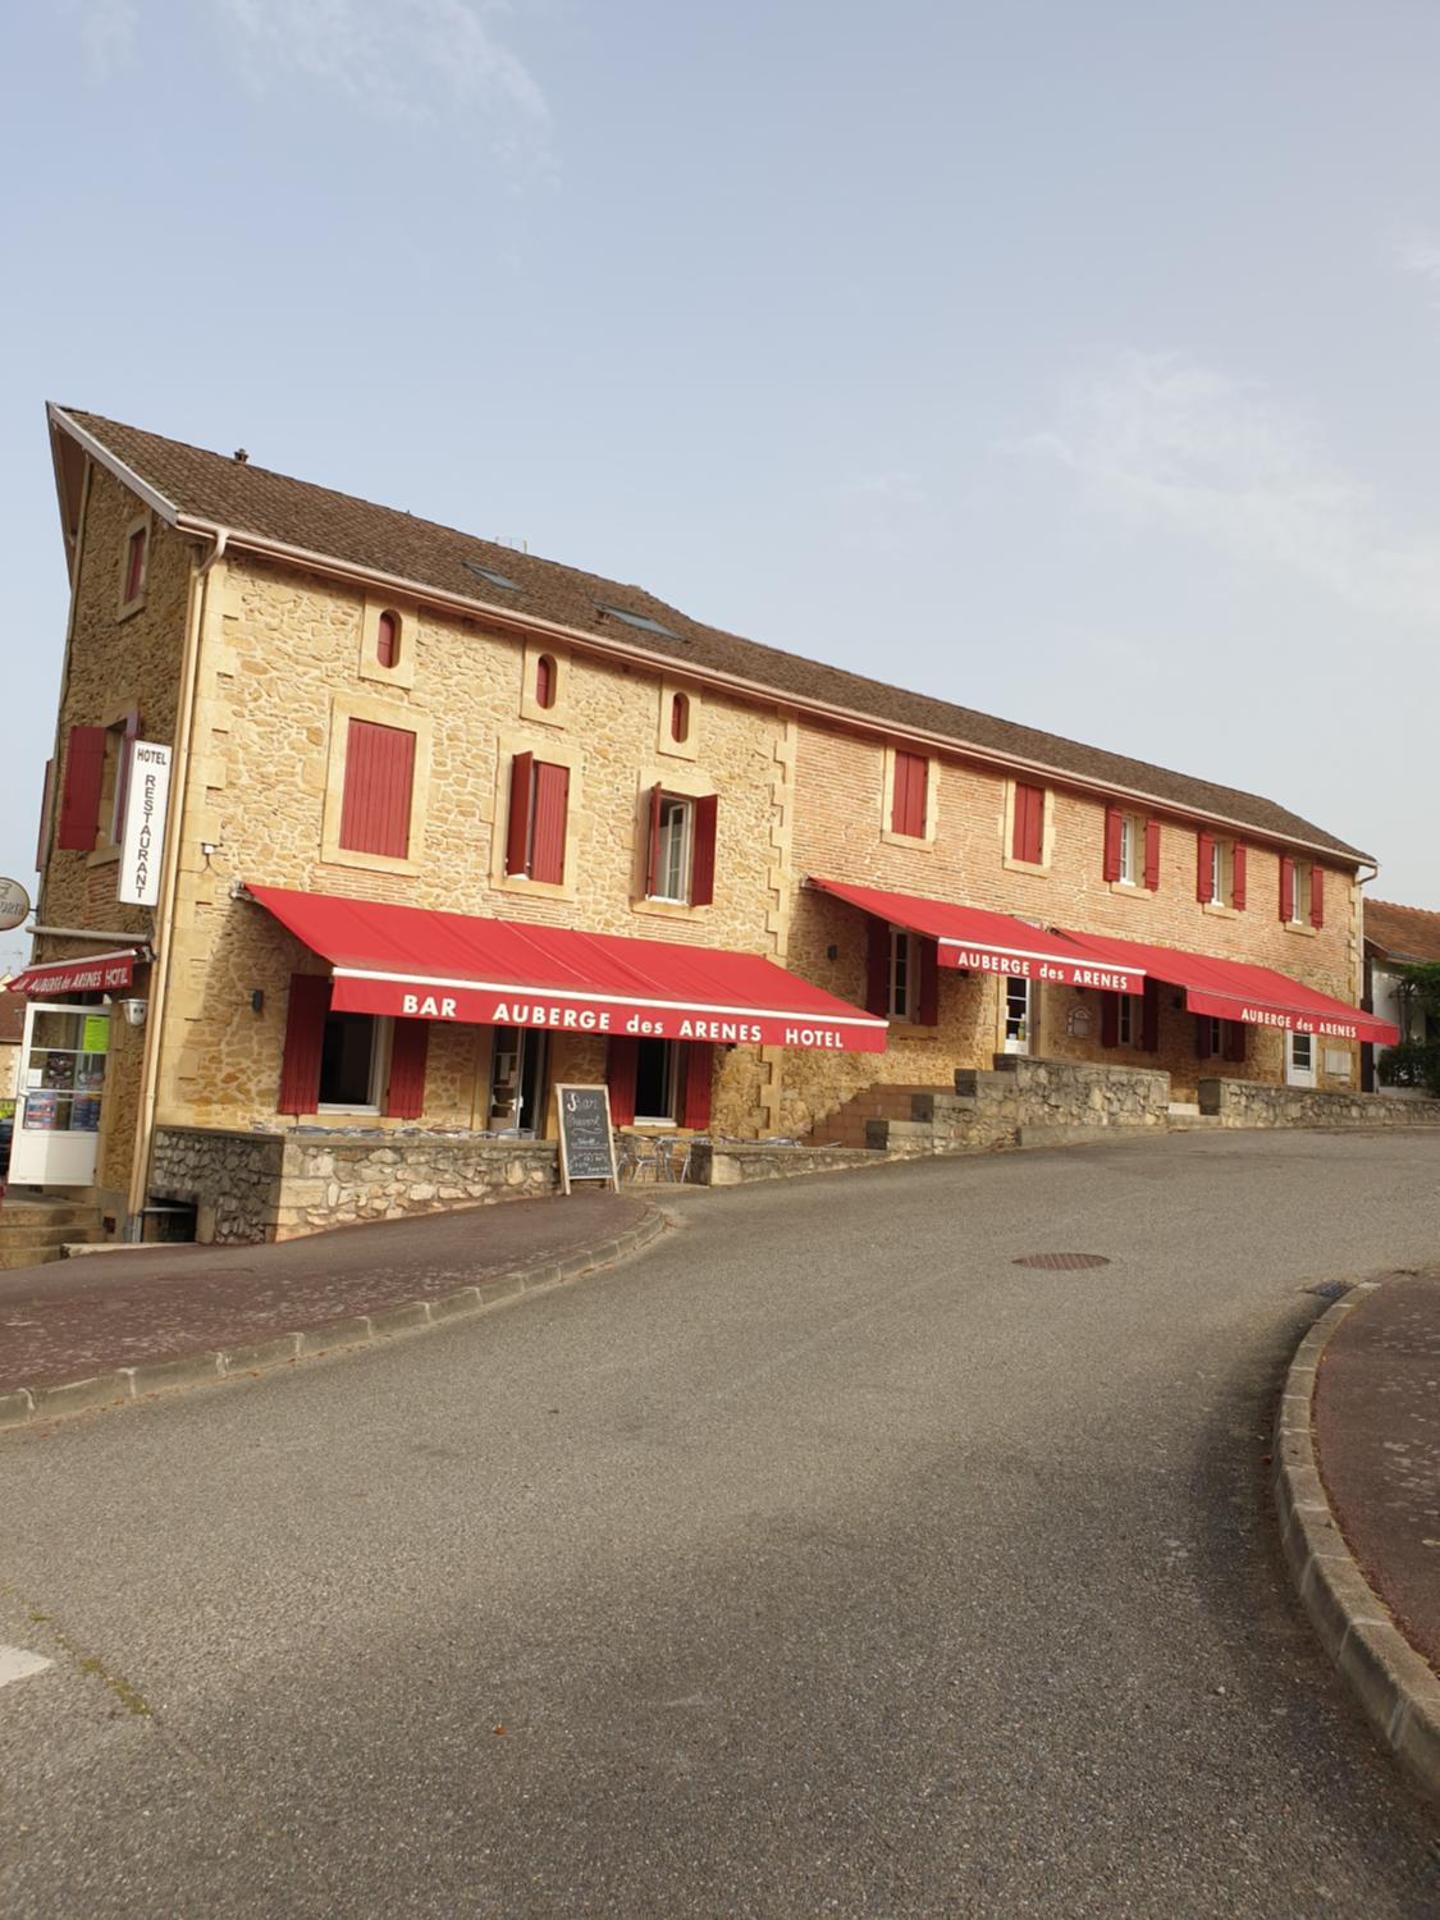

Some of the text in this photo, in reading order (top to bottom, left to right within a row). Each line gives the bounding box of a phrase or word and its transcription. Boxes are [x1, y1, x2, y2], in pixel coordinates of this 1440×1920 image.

[136, 748, 167, 766] HOTEL
[135, 774, 156, 899] RESTAURANT
[958, 952, 1128, 990] AUBERGE des ARENES
[402, 994, 843, 1048] BAR AUBERGE des ARENES HOTEL
[1241, 1007, 1357, 1038] AUBERGE des ARENES
